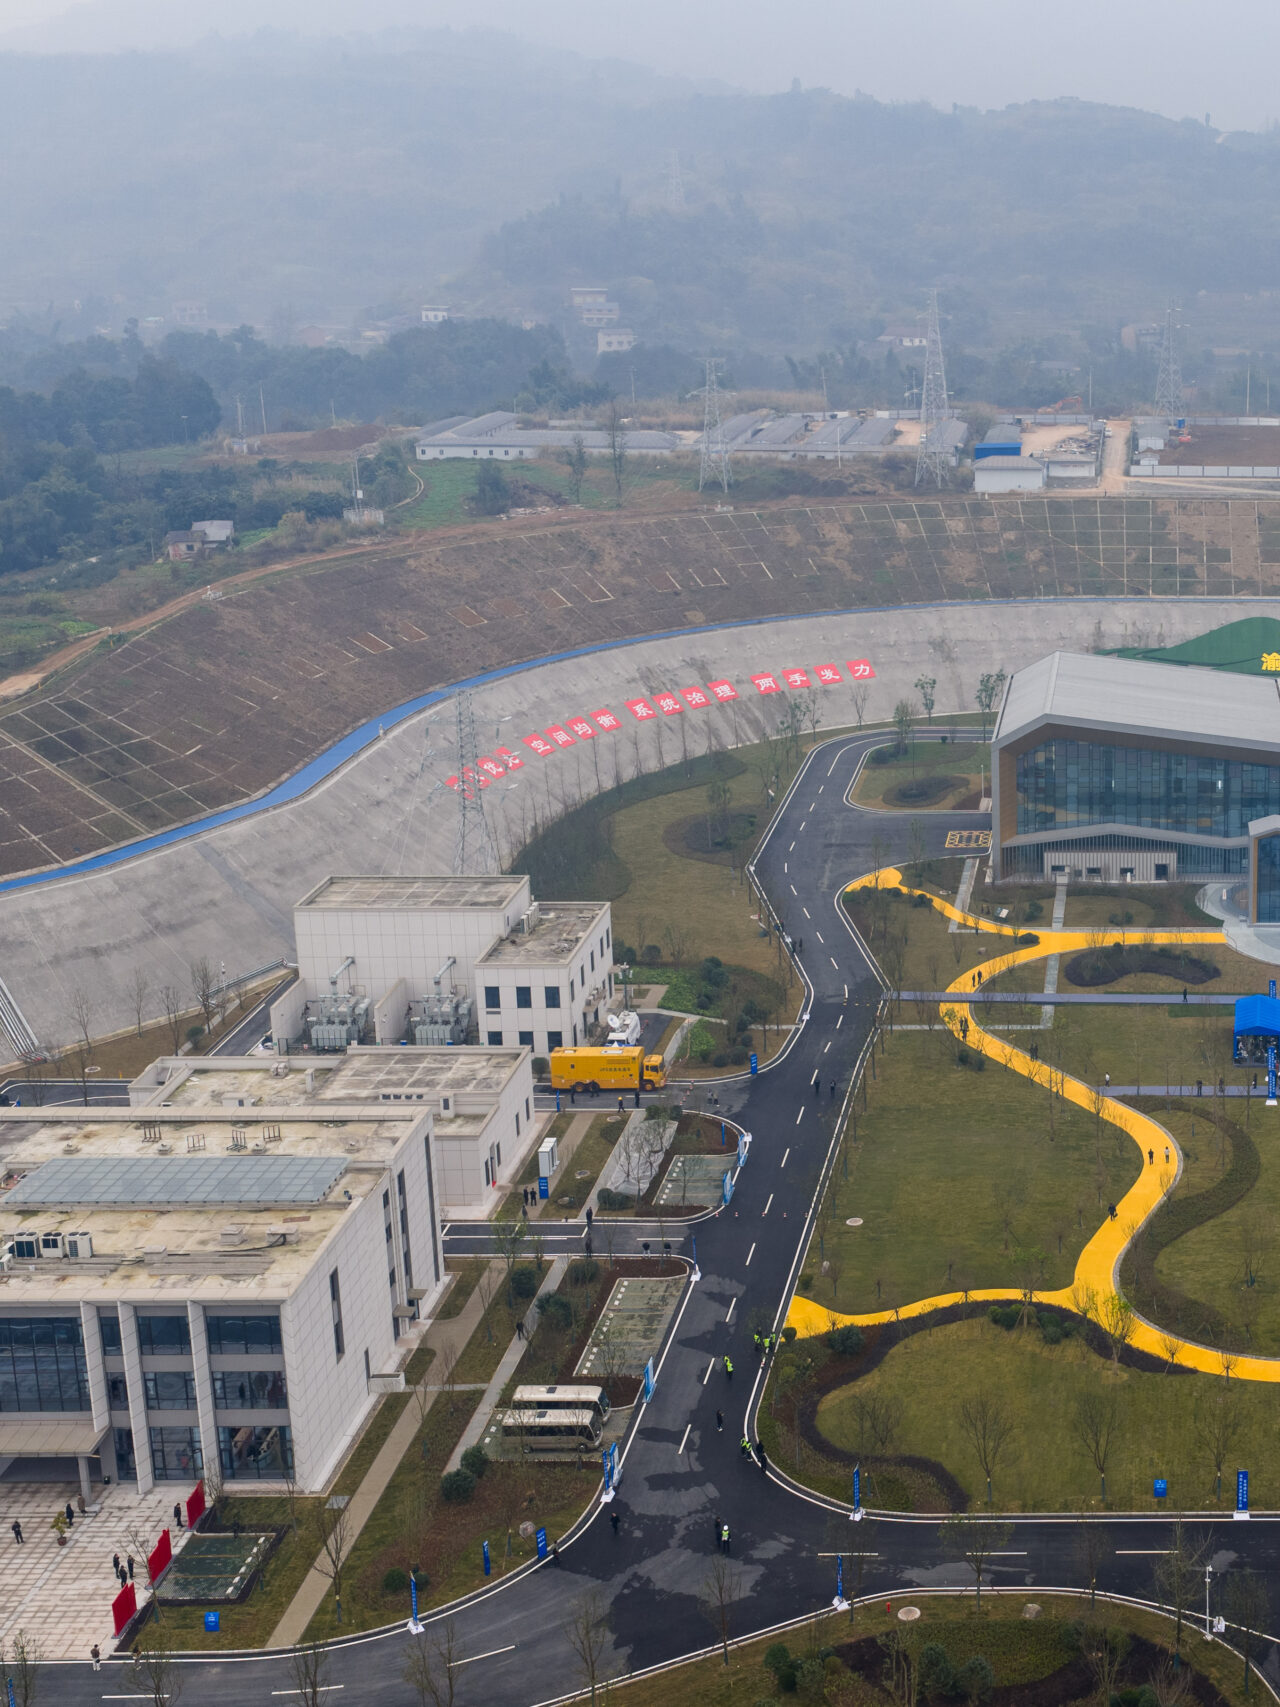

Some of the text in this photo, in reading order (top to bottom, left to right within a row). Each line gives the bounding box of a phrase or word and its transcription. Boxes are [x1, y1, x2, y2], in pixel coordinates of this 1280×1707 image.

[635, 684, 736, 717] 系统治理
[755, 662, 870, 690] 两手发力
